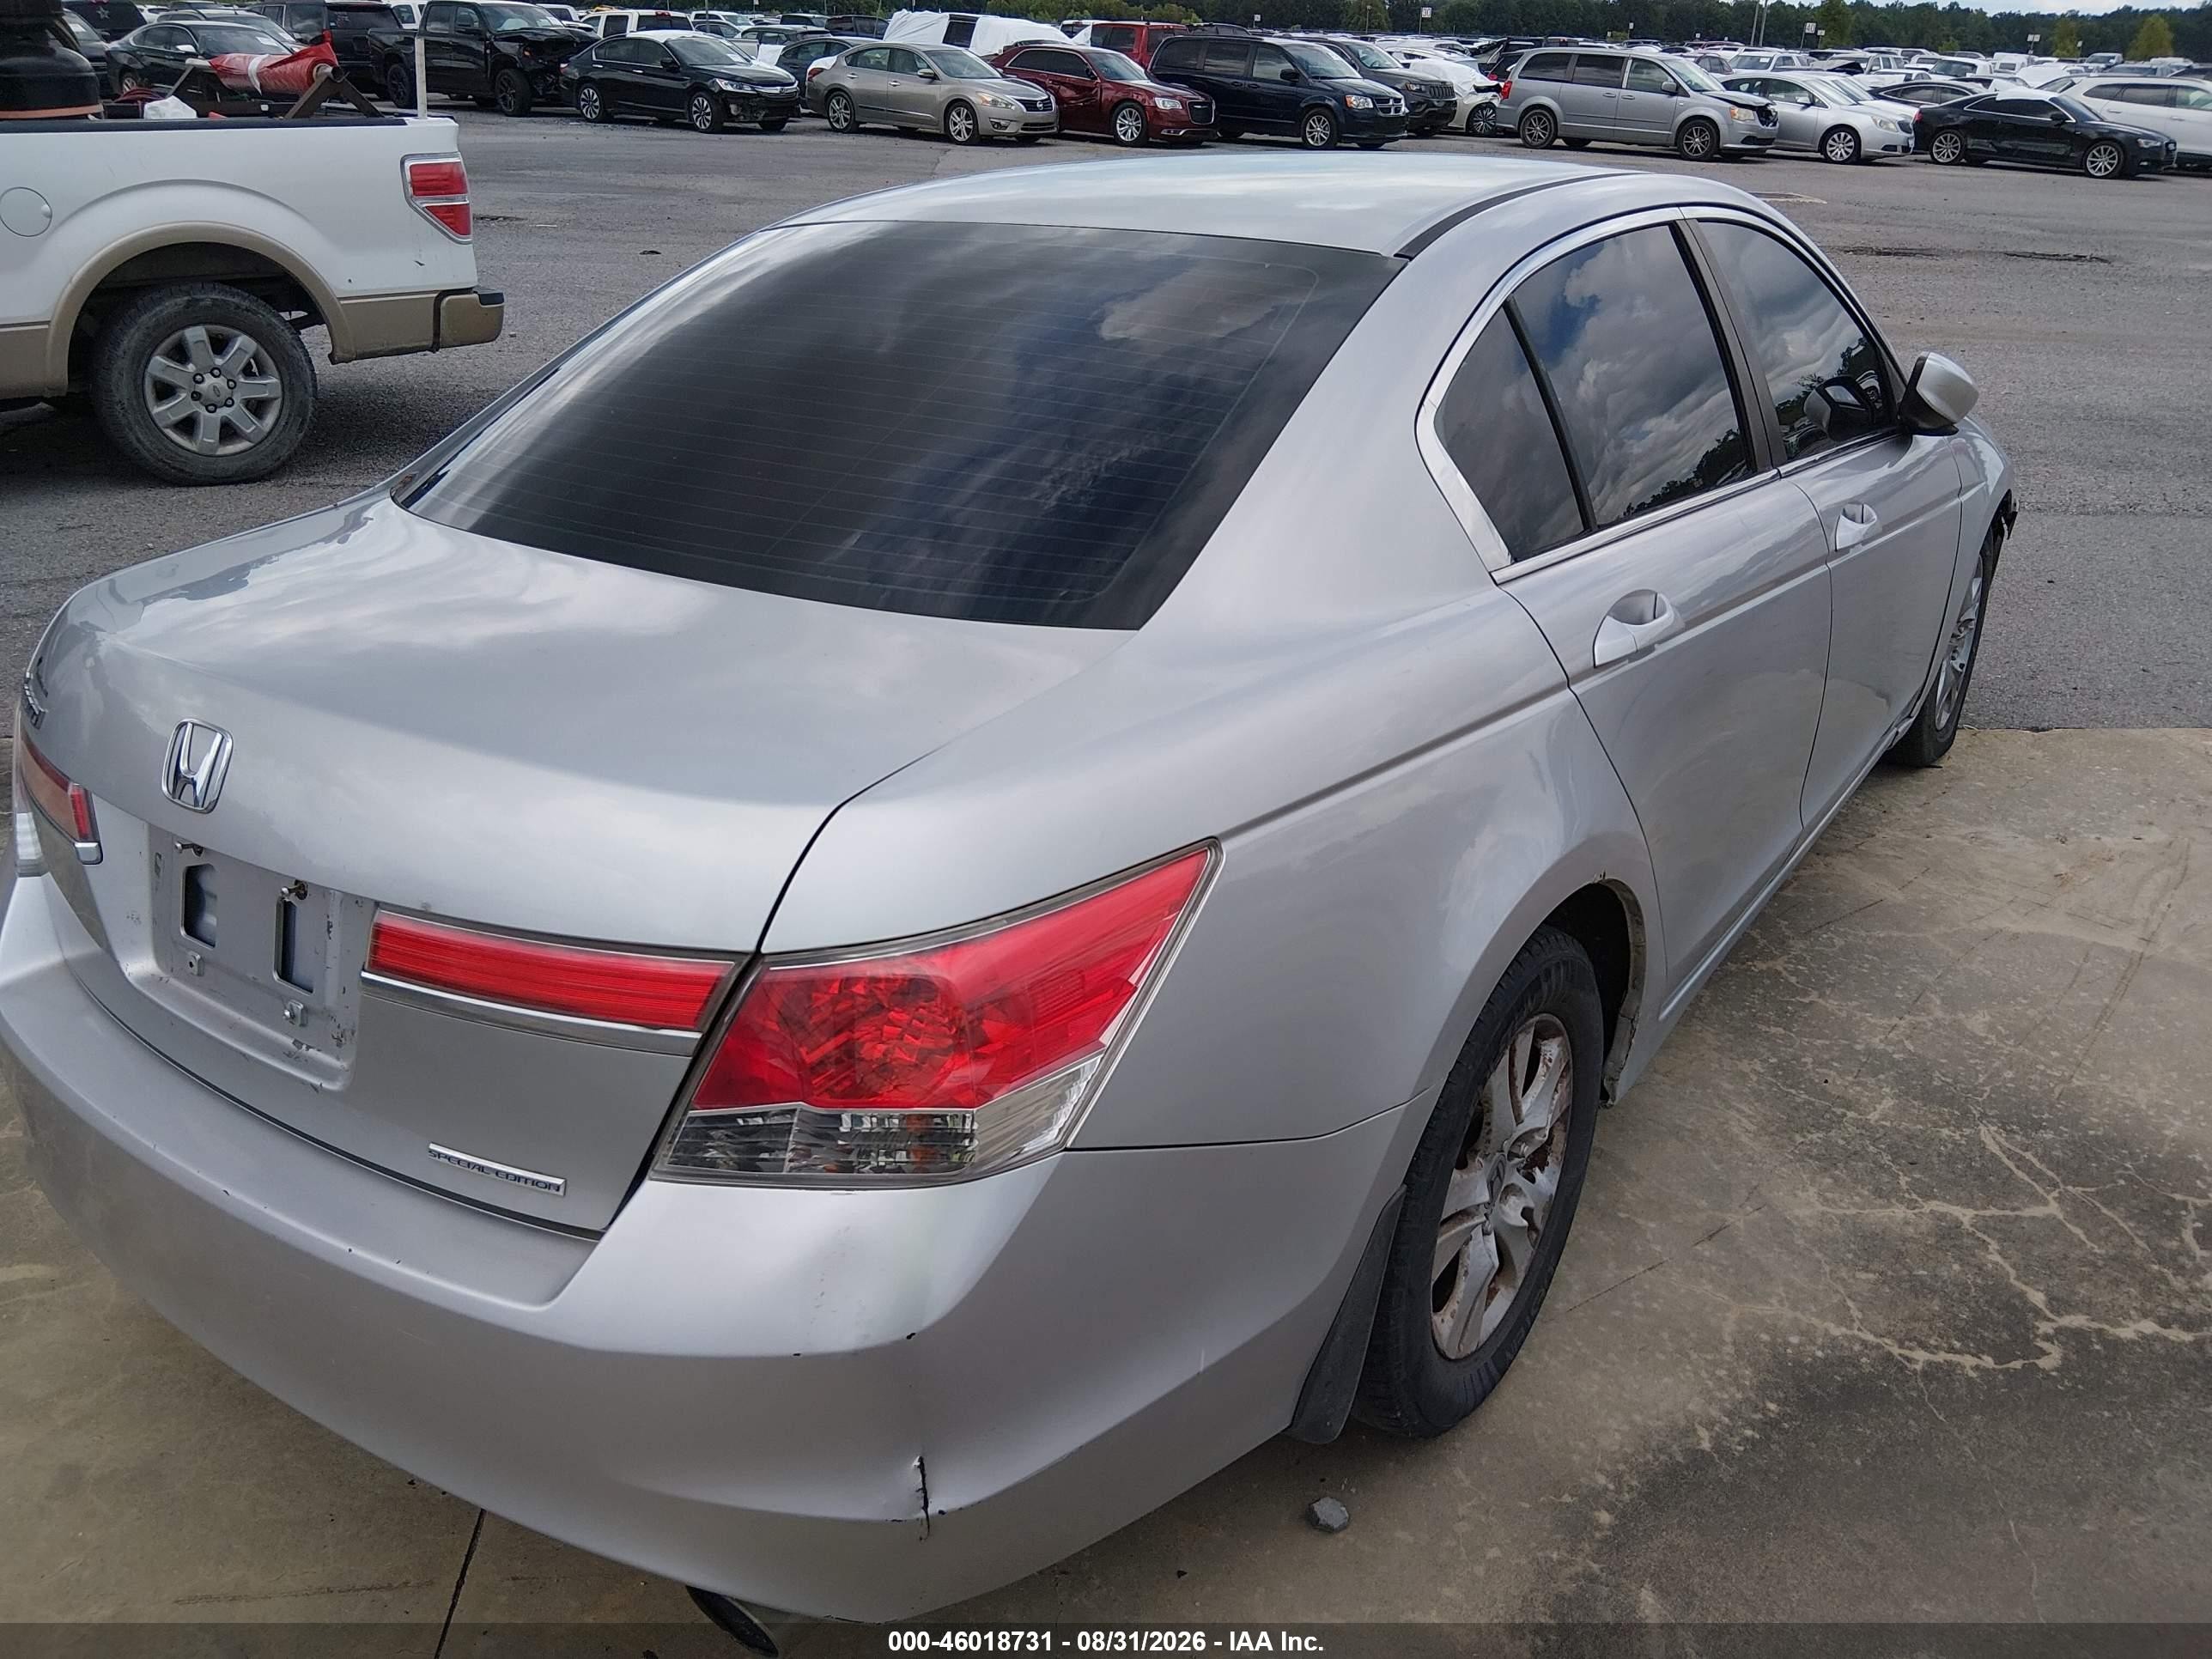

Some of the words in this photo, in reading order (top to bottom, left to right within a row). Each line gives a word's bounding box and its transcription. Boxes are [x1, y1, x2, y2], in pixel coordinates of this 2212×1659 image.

[1806, 23, 1815, 33] 40
[427, 1149, 490, 1176] SPECIAL
[495, 1170, 562, 1193] EDITION
